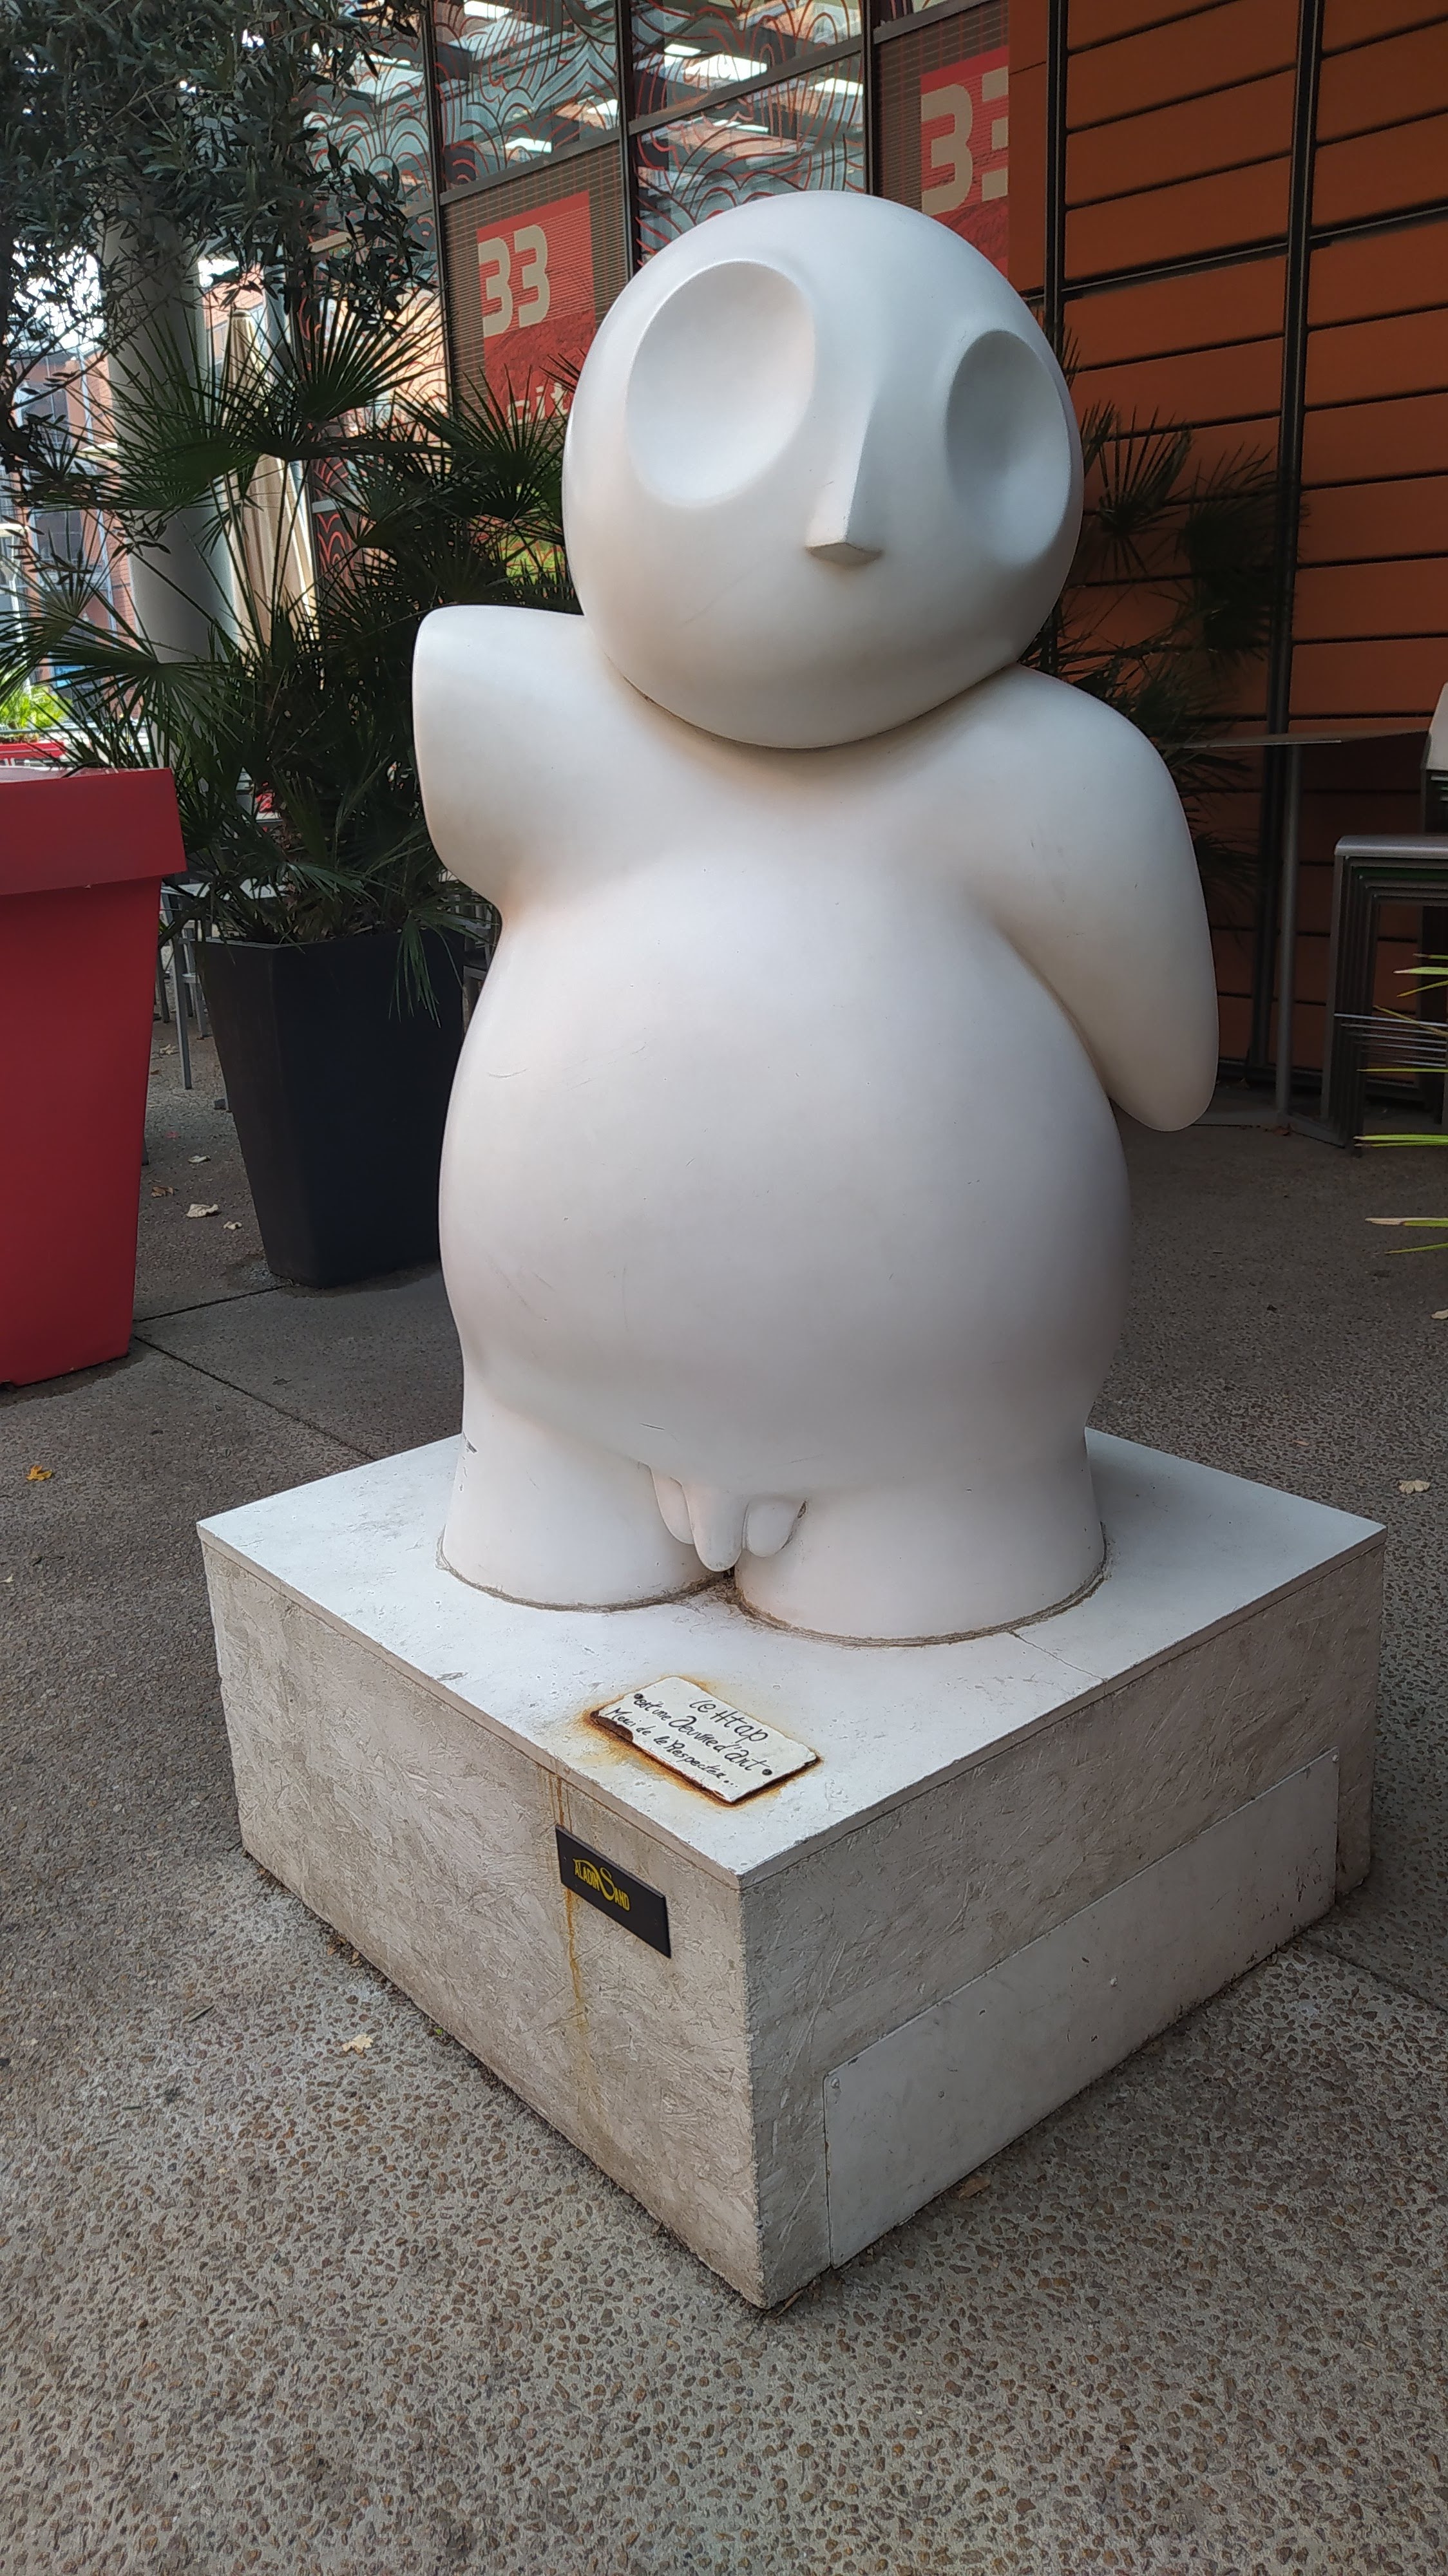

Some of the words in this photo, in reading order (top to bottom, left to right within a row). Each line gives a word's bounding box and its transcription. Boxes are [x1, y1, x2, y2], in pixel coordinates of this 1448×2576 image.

[479, 225, 550, 337] 33
[604, 1707, 642, 1727] Merci
[636, 1725, 656, 1736] de
[653, 1736, 671, 1745] le
[633, 1699, 664, 1712] est
[652, 1709, 672, 1721] une
